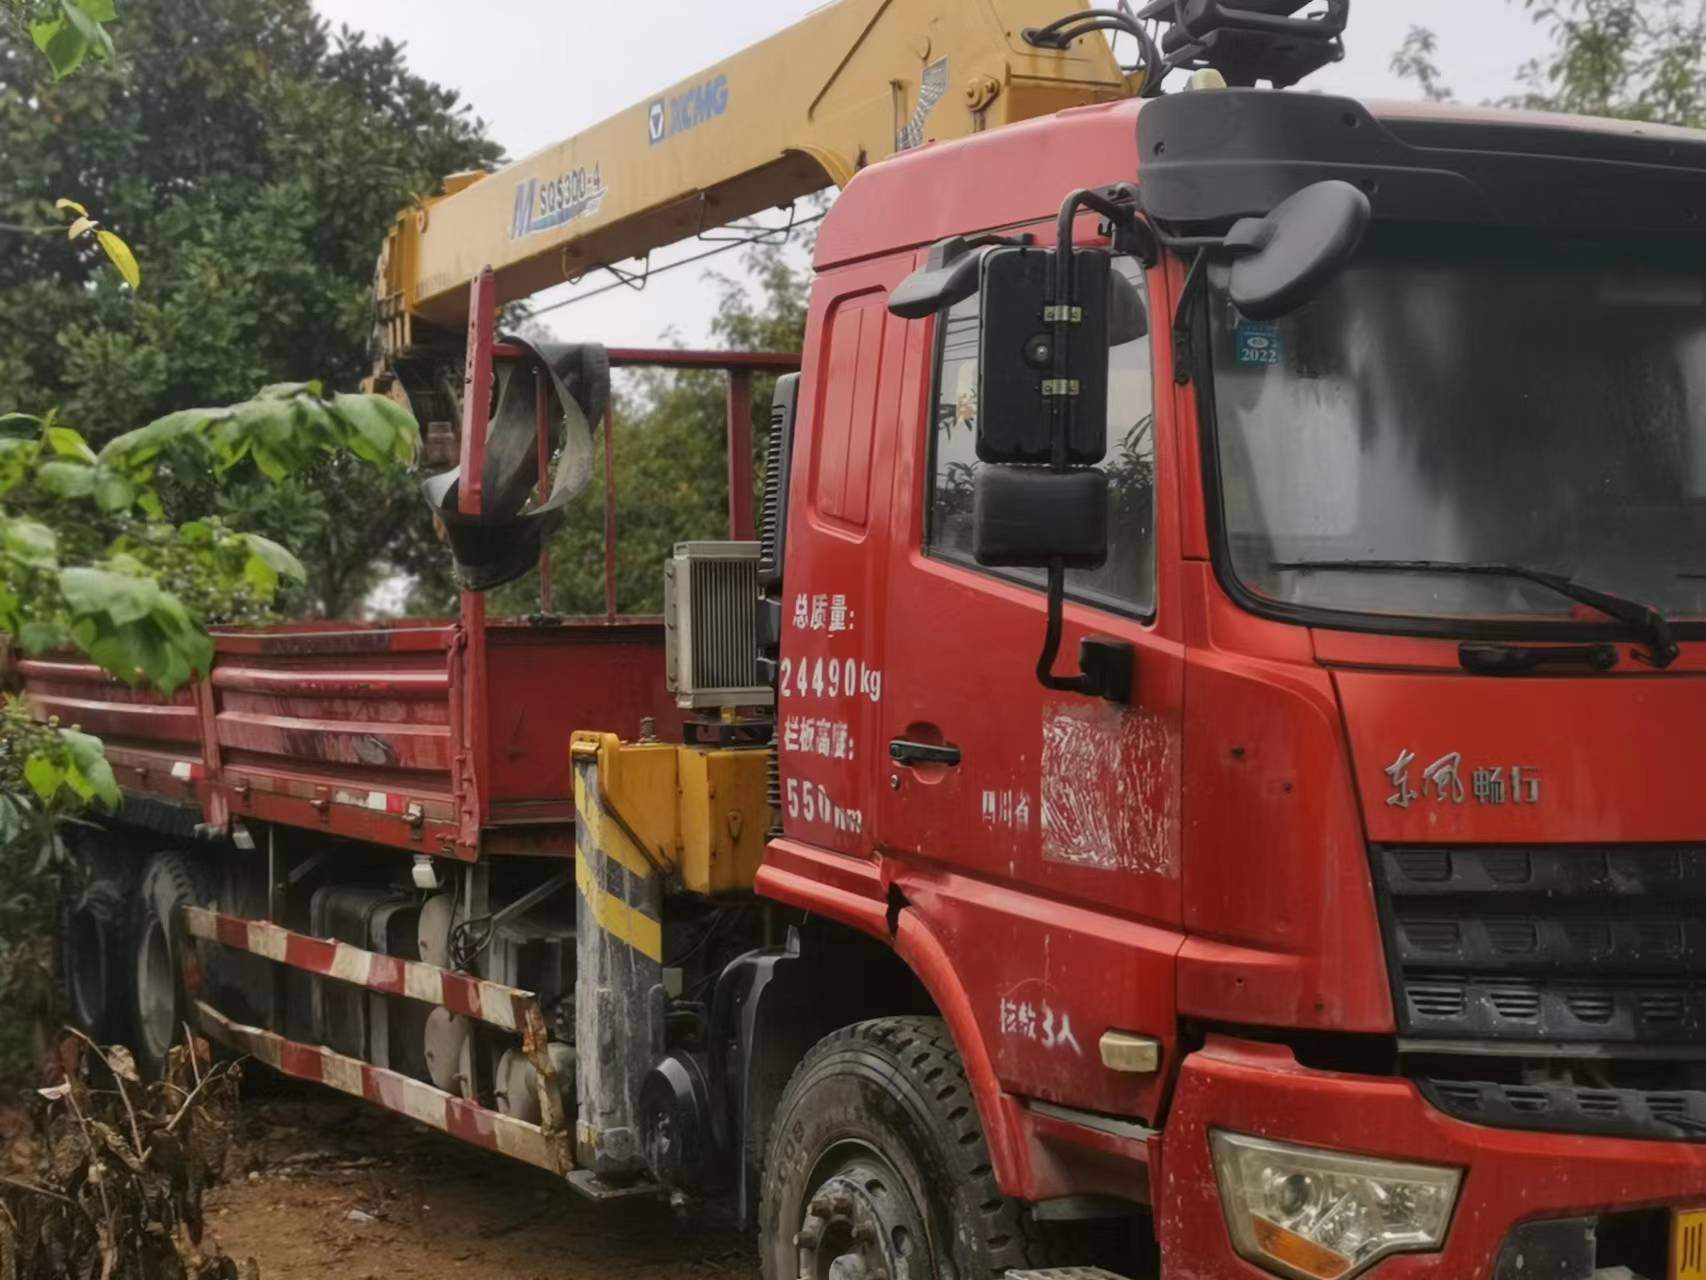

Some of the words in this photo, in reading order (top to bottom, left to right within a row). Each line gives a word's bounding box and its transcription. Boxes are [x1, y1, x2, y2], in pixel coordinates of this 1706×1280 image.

[671, 75, 729, 134] XCMG
[1241, 348, 1277, 362] 2022
[781, 657, 882, 701] 24490kg
